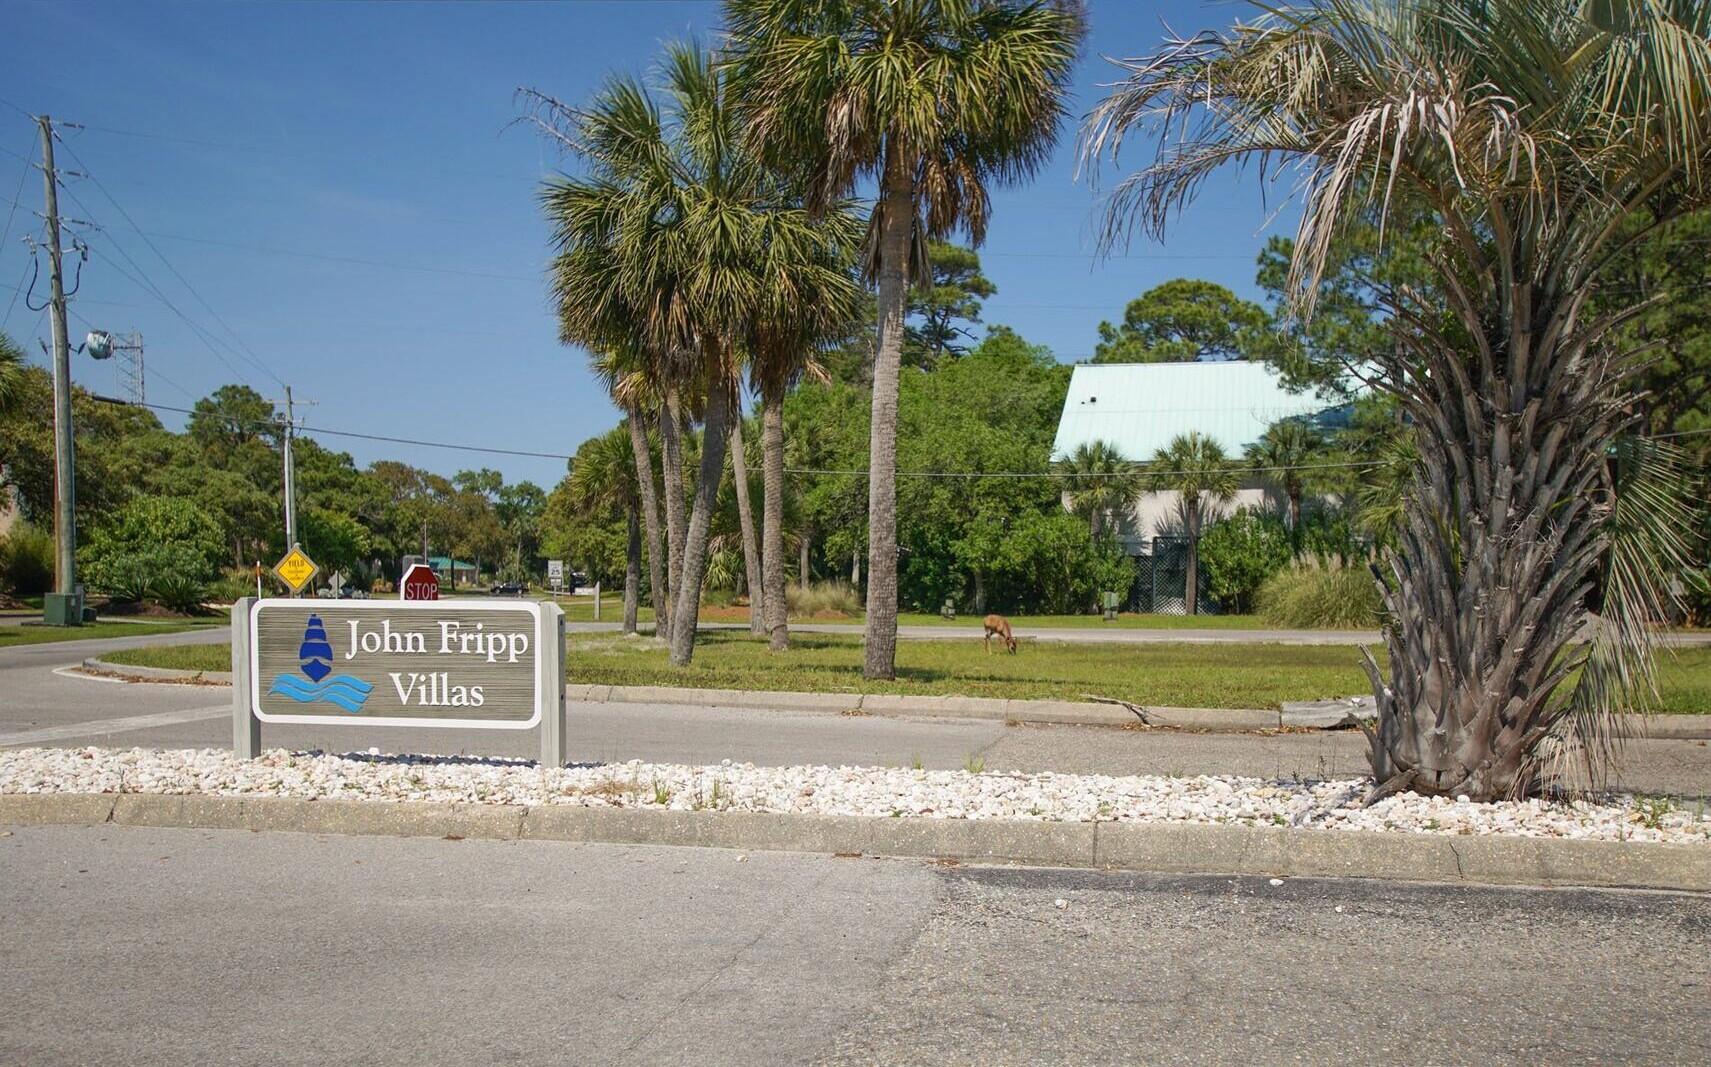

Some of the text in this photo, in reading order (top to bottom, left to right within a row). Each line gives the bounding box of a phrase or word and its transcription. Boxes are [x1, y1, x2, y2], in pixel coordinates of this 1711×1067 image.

[406, 583, 438, 600] STOP
[345, 620, 529, 662] John Fripp
[388, 672, 484, 707] Villas
